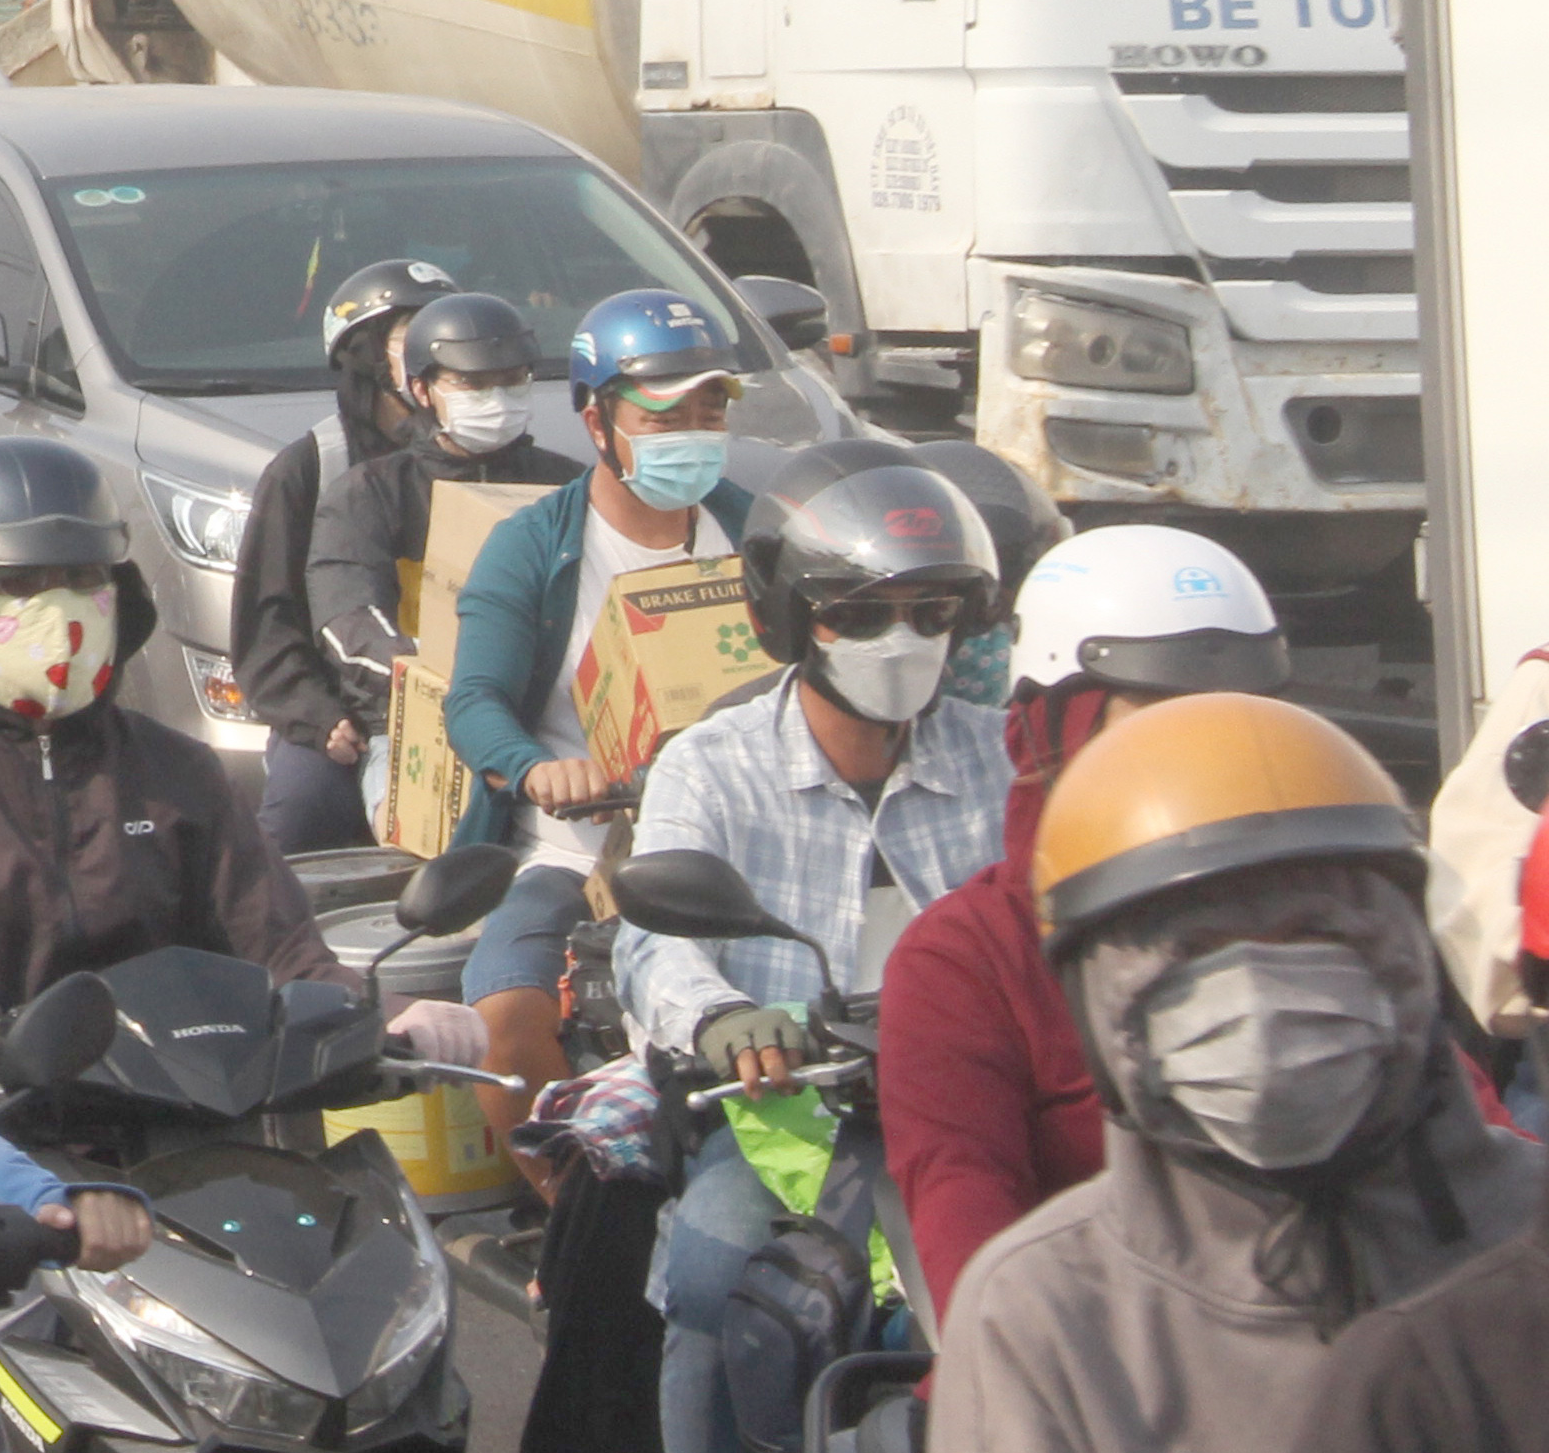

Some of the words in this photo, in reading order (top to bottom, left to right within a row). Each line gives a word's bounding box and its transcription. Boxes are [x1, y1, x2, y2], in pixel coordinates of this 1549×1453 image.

[1108, 44, 1269, 68] HOWO
[638, 589, 695, 611] BRAKE
[171, 1023, 248, 1040] HONDA
